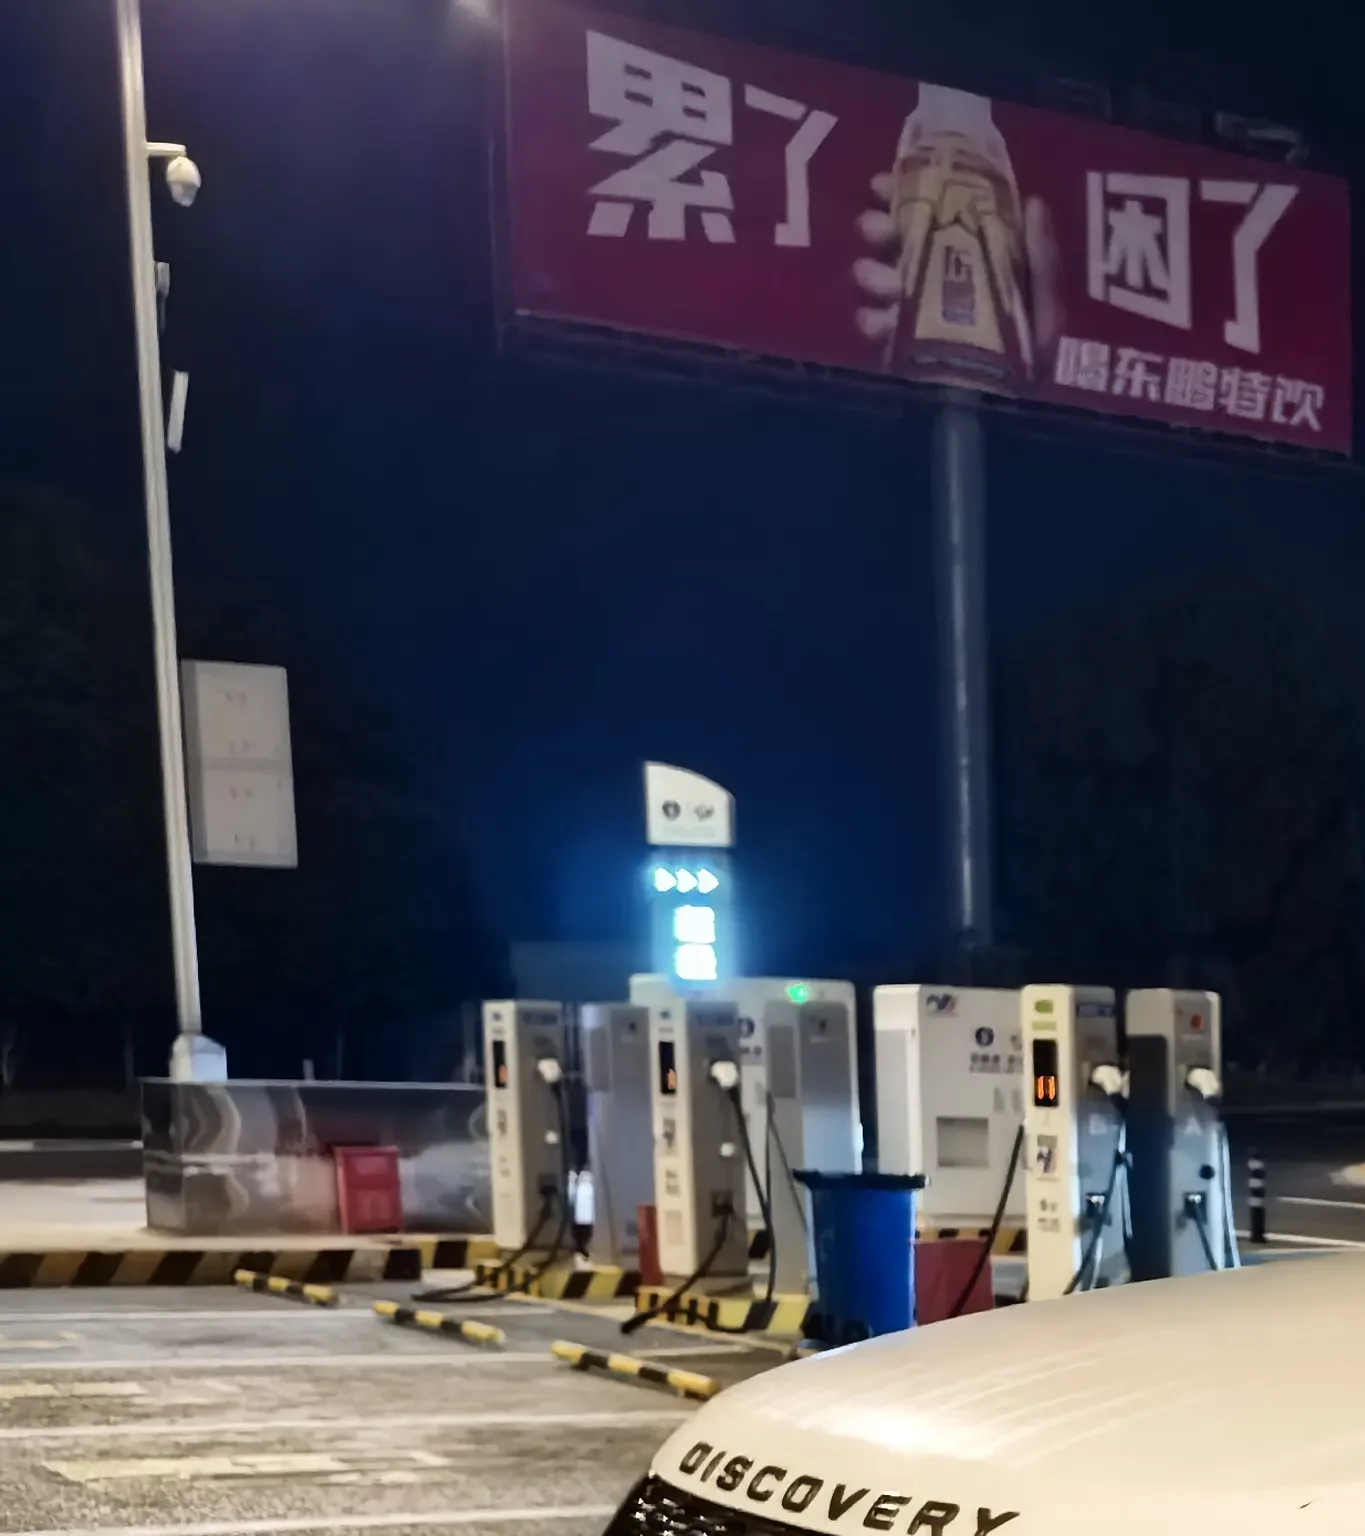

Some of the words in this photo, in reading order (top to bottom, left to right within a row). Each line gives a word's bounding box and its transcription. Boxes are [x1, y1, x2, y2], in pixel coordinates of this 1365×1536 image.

[585, 29, 839, 249] 累了
[1086, 169, 1300, 354] 困了
[1054, 335, 1325, 433] 喝东鹏特饮
